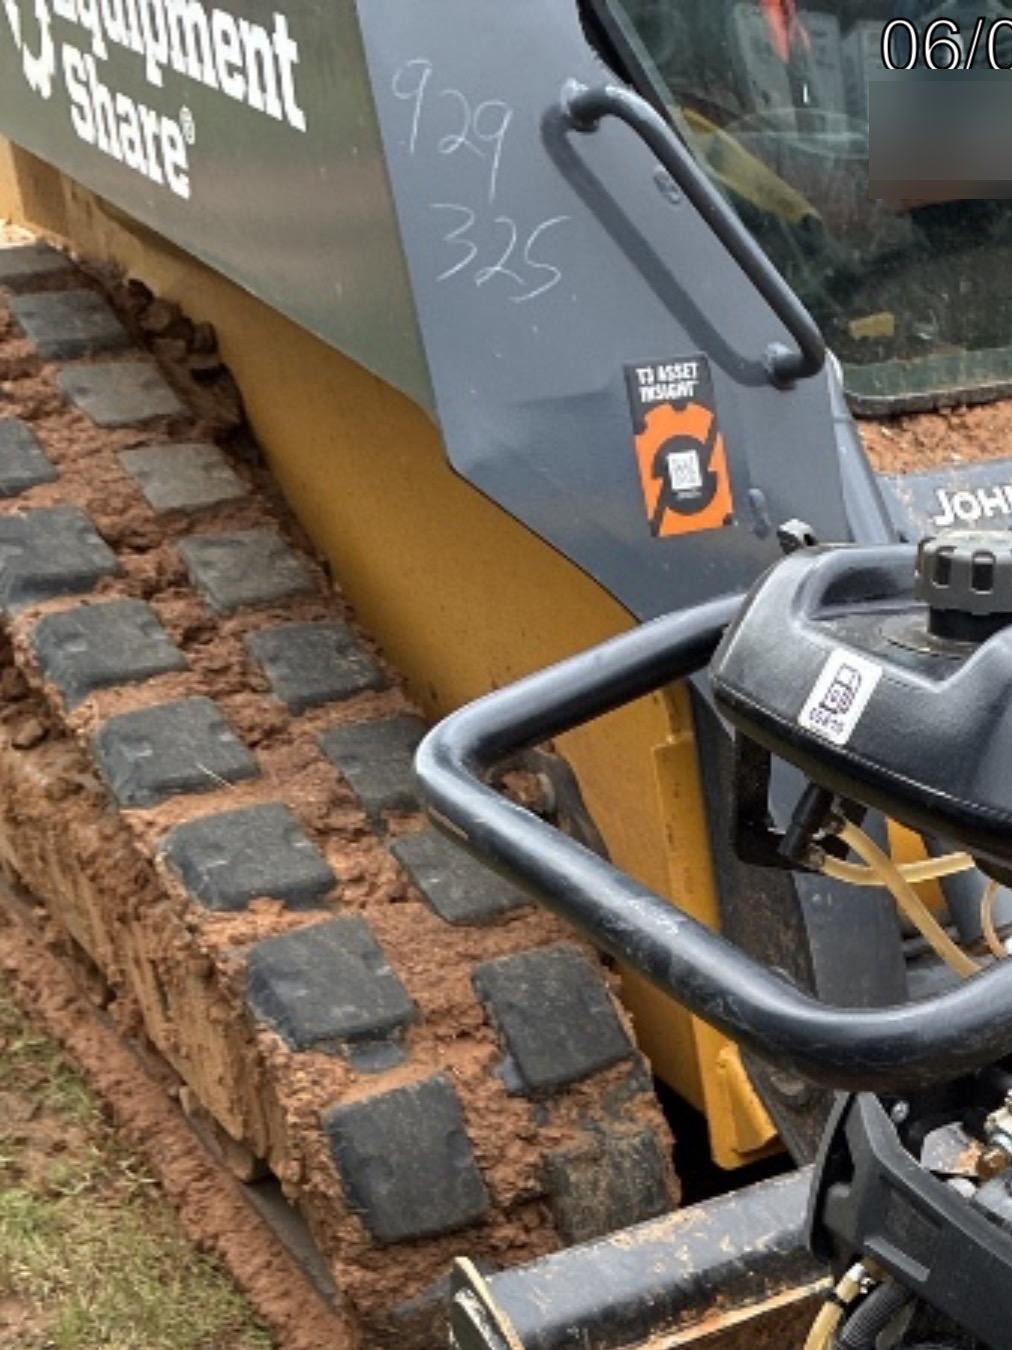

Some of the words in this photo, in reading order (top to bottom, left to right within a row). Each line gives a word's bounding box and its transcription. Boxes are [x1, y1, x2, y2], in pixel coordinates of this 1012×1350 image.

[50, 0, 307, 132] quipment
[392, 59, 513, 204] 929
[429, 203, 572, 304] 325
[657, 362, 698, 381] ASSET
